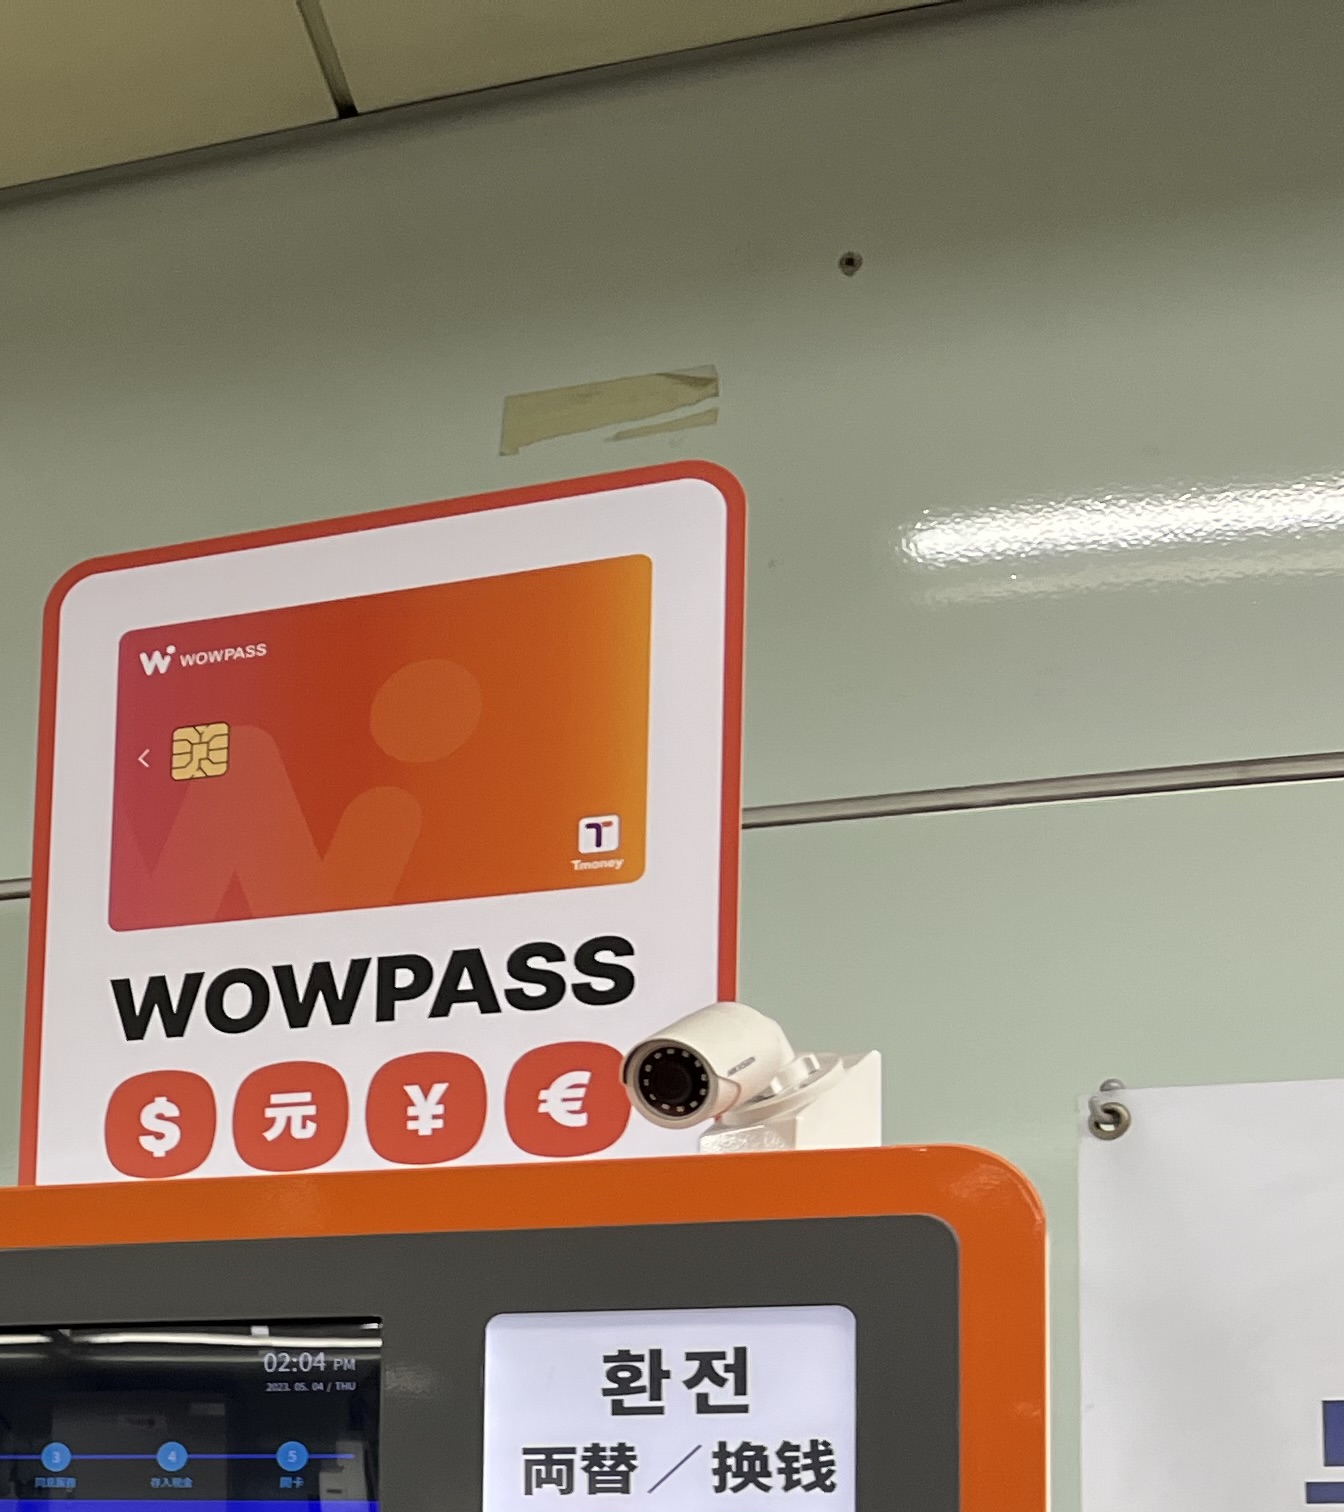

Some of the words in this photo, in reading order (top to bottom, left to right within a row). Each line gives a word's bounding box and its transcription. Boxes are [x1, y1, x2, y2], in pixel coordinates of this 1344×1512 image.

[179, 643, 268, 668] WOWPASS
[571, 857, 624, 871] Tmoney
[110, 935, 635, 1041] WOWPASS
[139, 1097, 181, 1157] $
[263, 1091, 317, 1140] 元
[403, 1083, 449, 1136] ¥
[537, 1071, 591, 1126] €
[264, 1352, 326, 1373] 02:04
[333, 1358, 356, 1371] PM
[335, 1381, 357, 1391] THU
[601, 1345, 749, 1417] 환전
